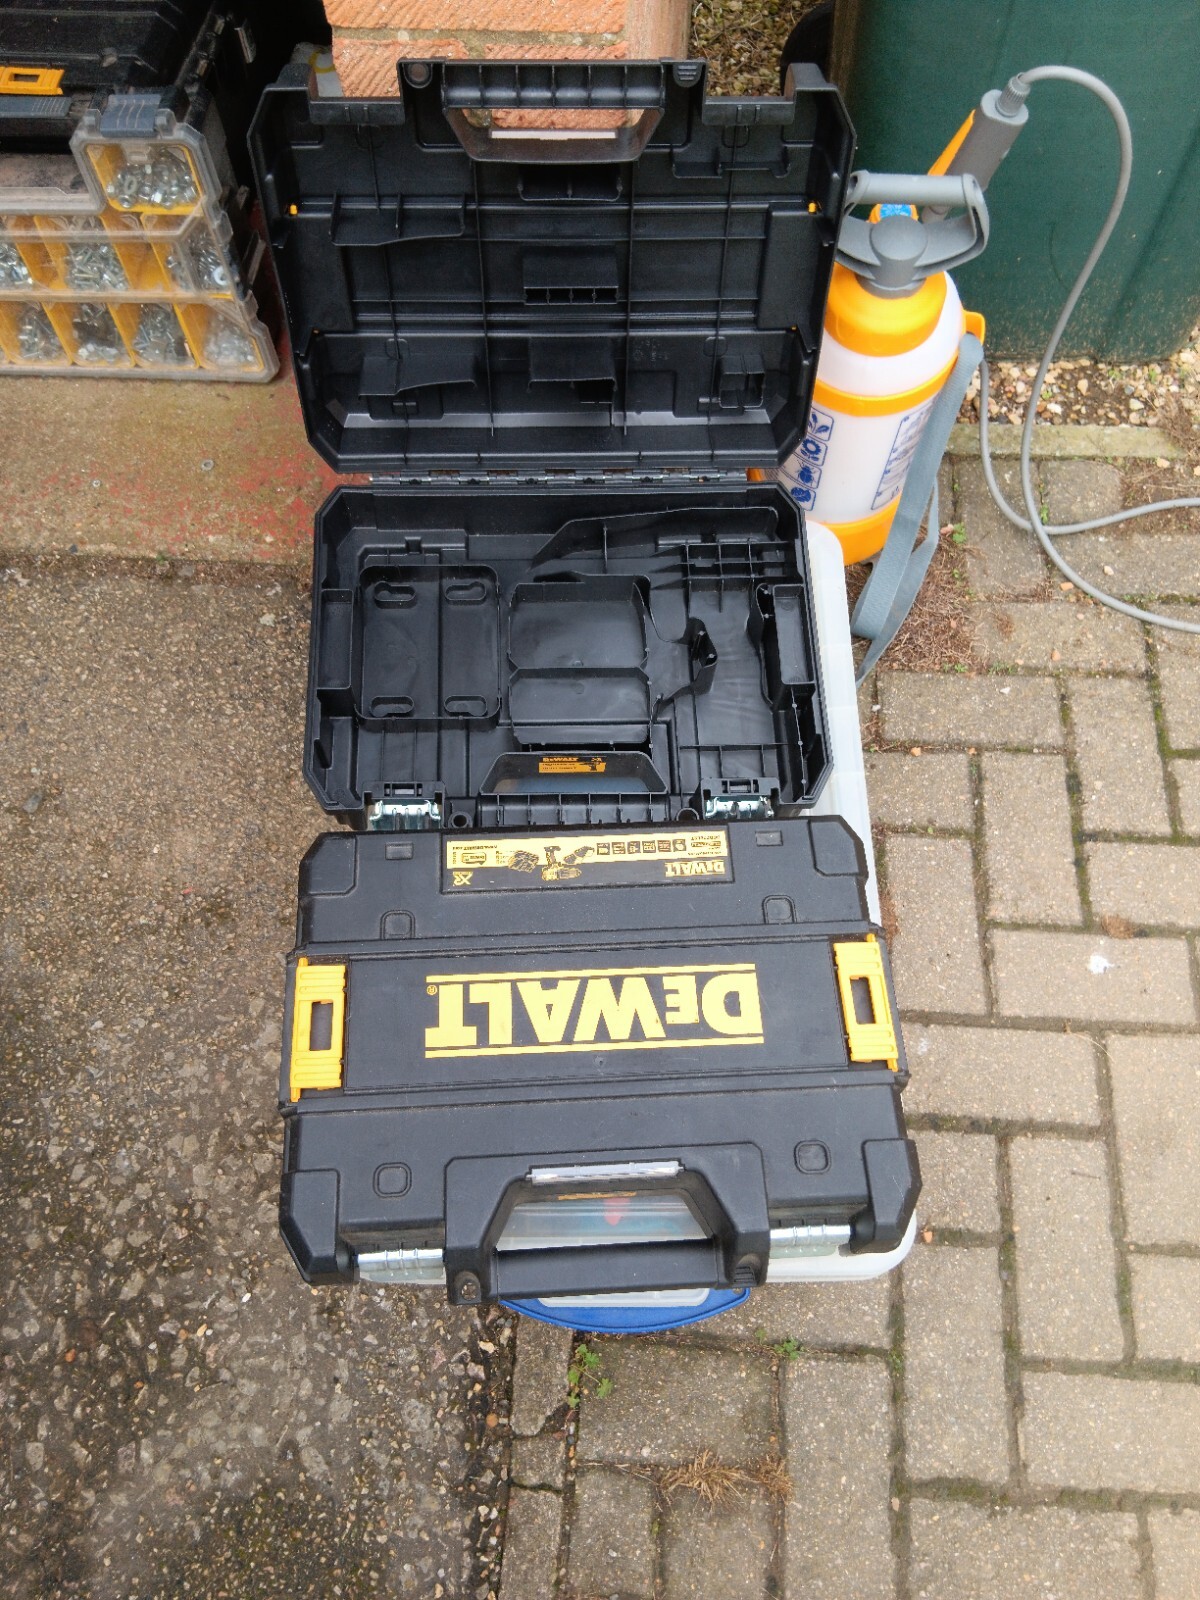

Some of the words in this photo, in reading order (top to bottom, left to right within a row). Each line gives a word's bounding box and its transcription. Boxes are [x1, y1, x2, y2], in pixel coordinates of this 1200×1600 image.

[664, 860, 725, 877] DEWALT
[453, 871, 474, 886] XR
[424, 972, 763, 1048] DEWALT
